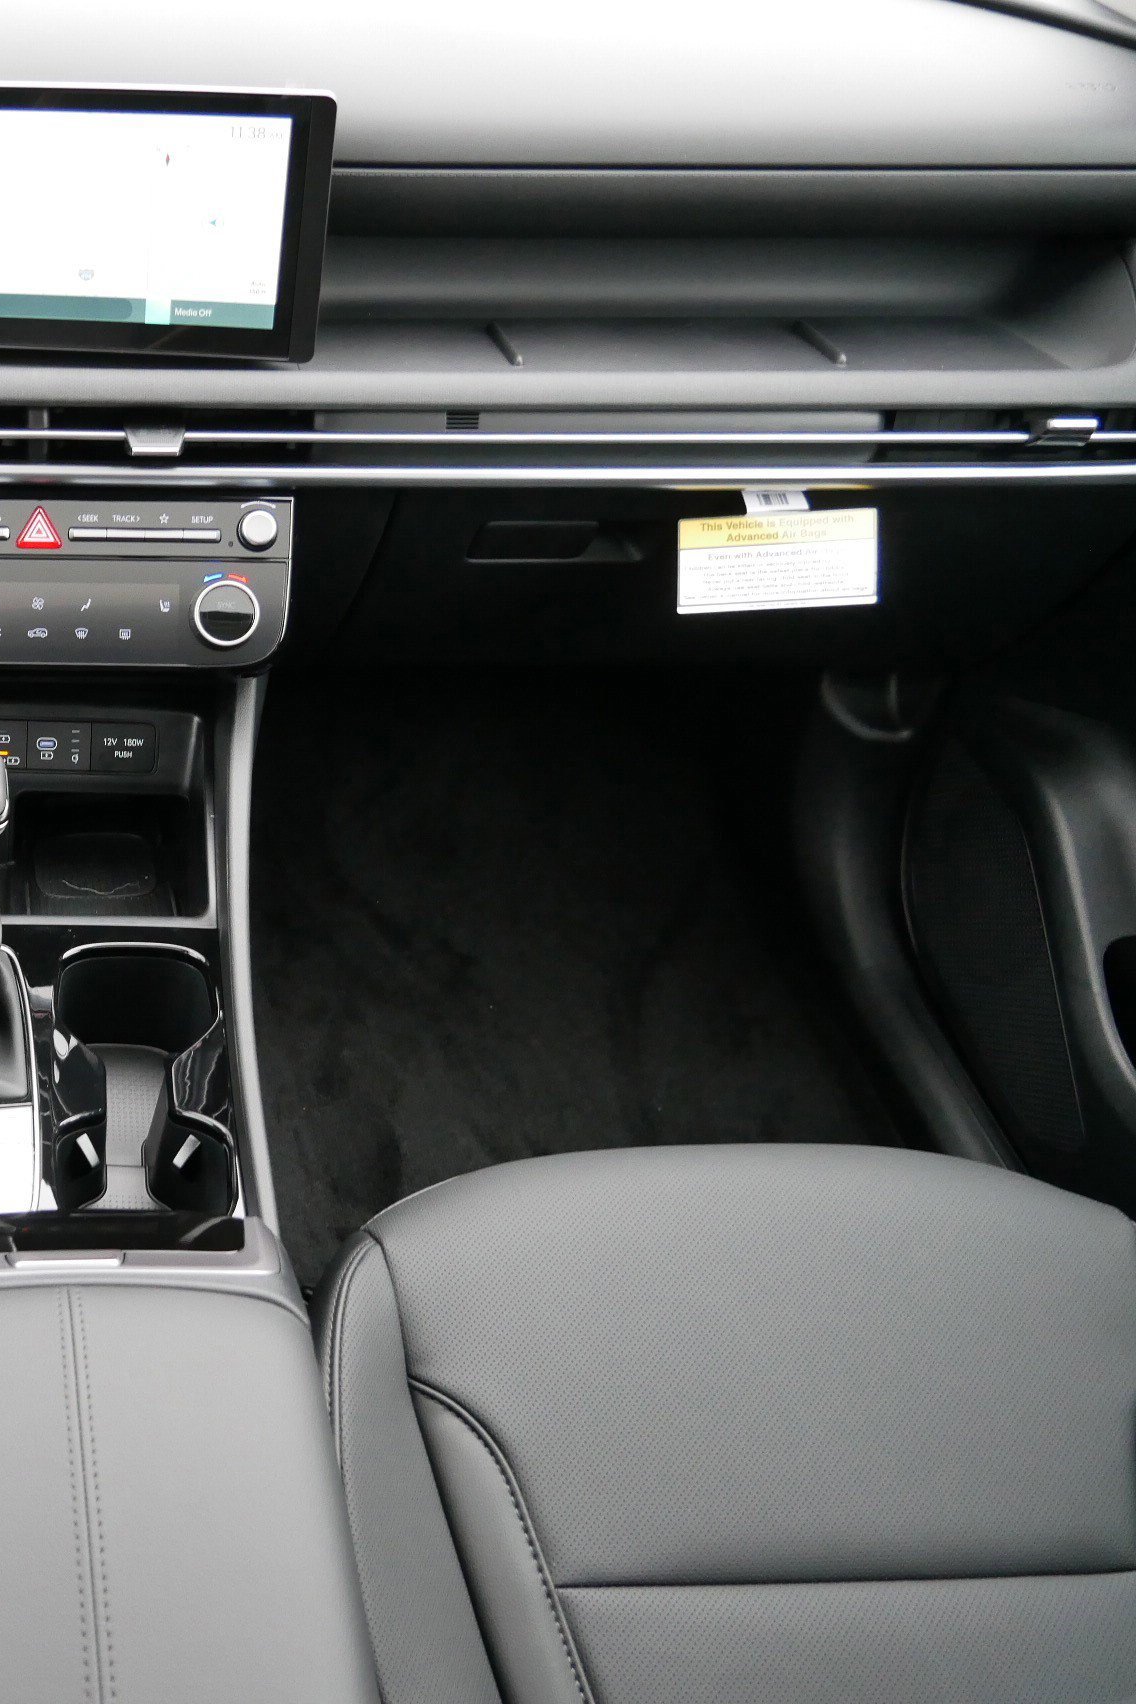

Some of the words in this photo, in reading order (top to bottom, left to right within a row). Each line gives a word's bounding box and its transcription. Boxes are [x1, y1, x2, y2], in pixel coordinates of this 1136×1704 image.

[231, 126, 266, 139] 1138
[174, 307, 198, 317] Media
[198, 308, 213, 318] Off
[191, 515, 214, 524] SETUP
[700, 522, 723, 532] This
[726, 520, 763, 531] Vehicle
[767, 519, 776, 528] is
[779, 515, 829, 528] Equipped
[832, 514, 855, 524] with
[726, 531, 779, 543] Advanced
[782, 530, 796, 540] Air
[800, 528, 827, 540] Bags
[707, 553, 731, 561] Even
[734, 551, 753, 560] with
[756, 549, 803, 559] Advanced
[103, 737, 118, 747] 12V
[123, 738, 145, 748] 180W
[114, 750, 133, 759] PUSH
